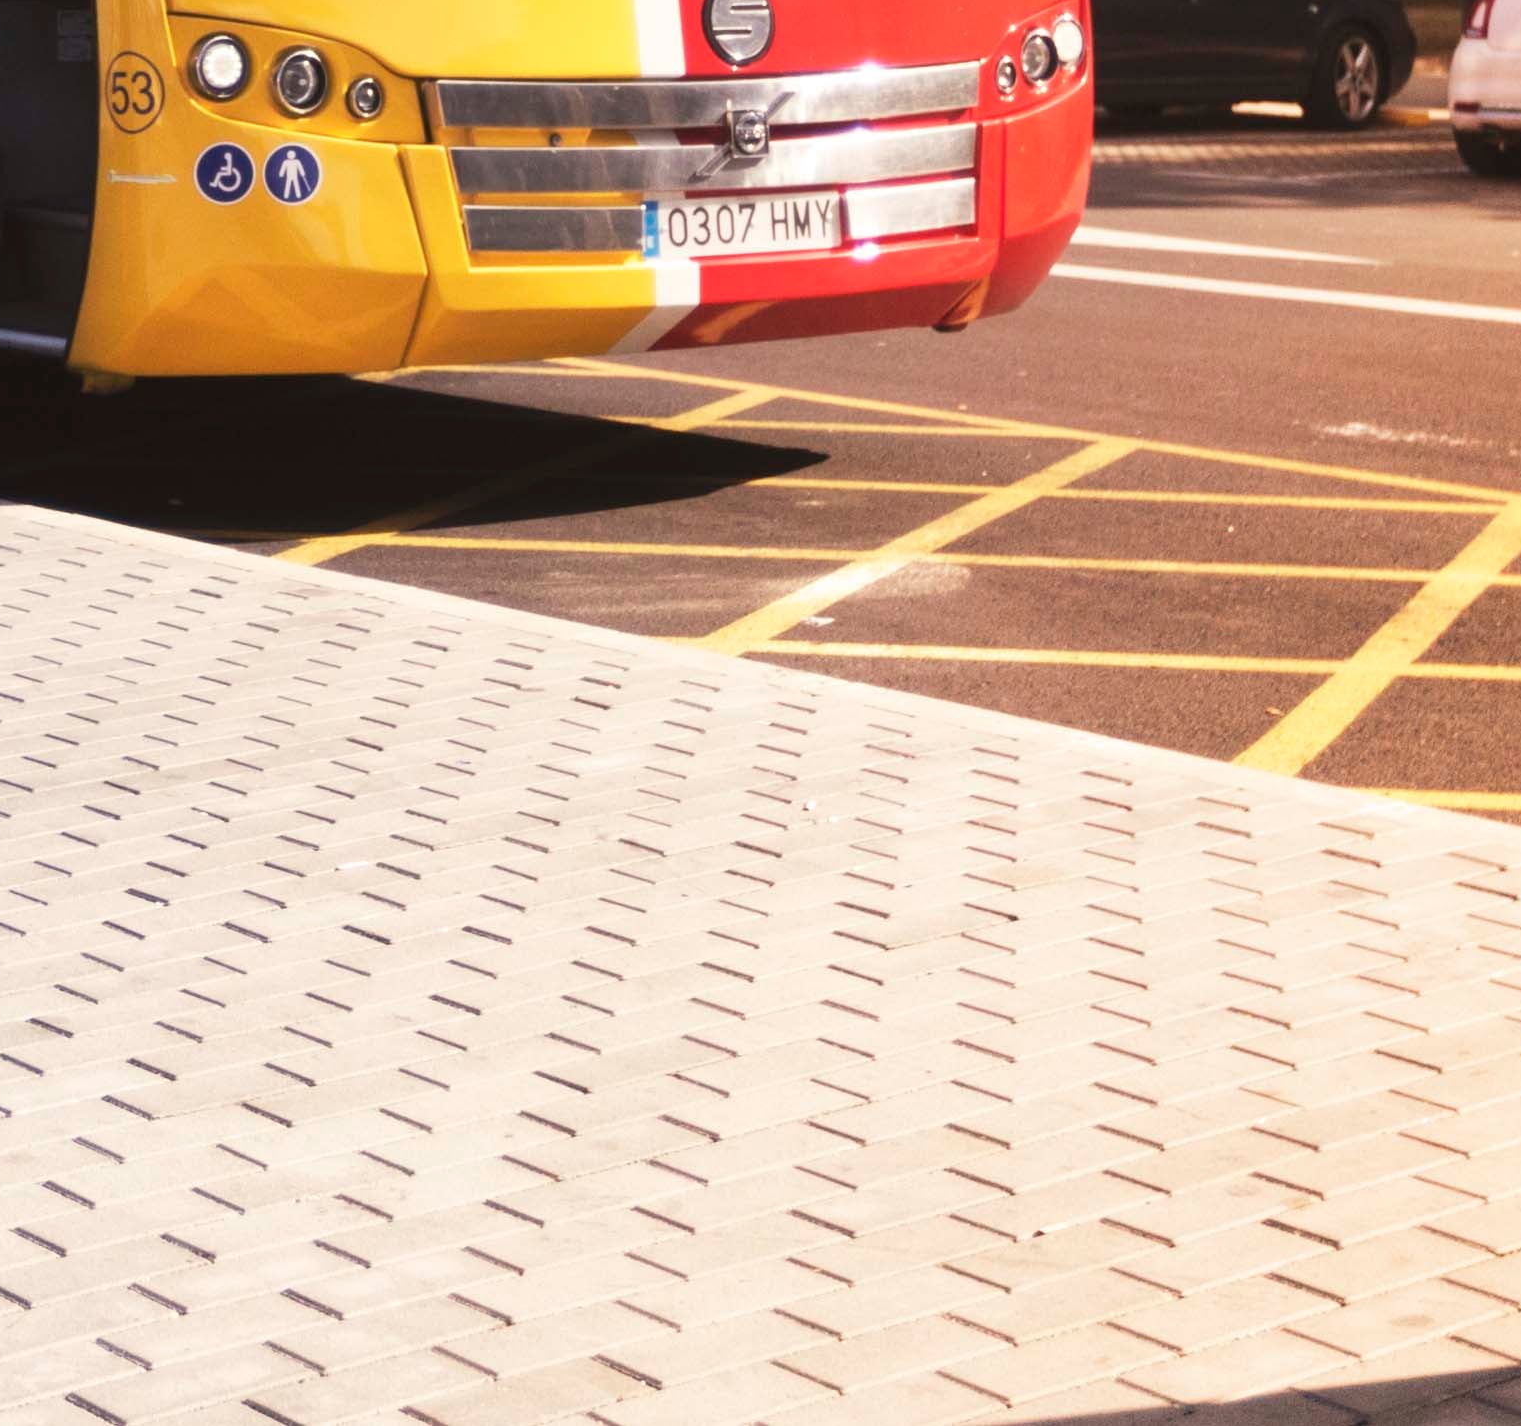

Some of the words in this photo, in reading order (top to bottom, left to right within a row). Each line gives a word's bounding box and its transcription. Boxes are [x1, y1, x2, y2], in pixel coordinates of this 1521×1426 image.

[110, 70, 156, 115] 53
[667, 202, 757, 248] 0307
[770, 198, 831, 242] HMY
